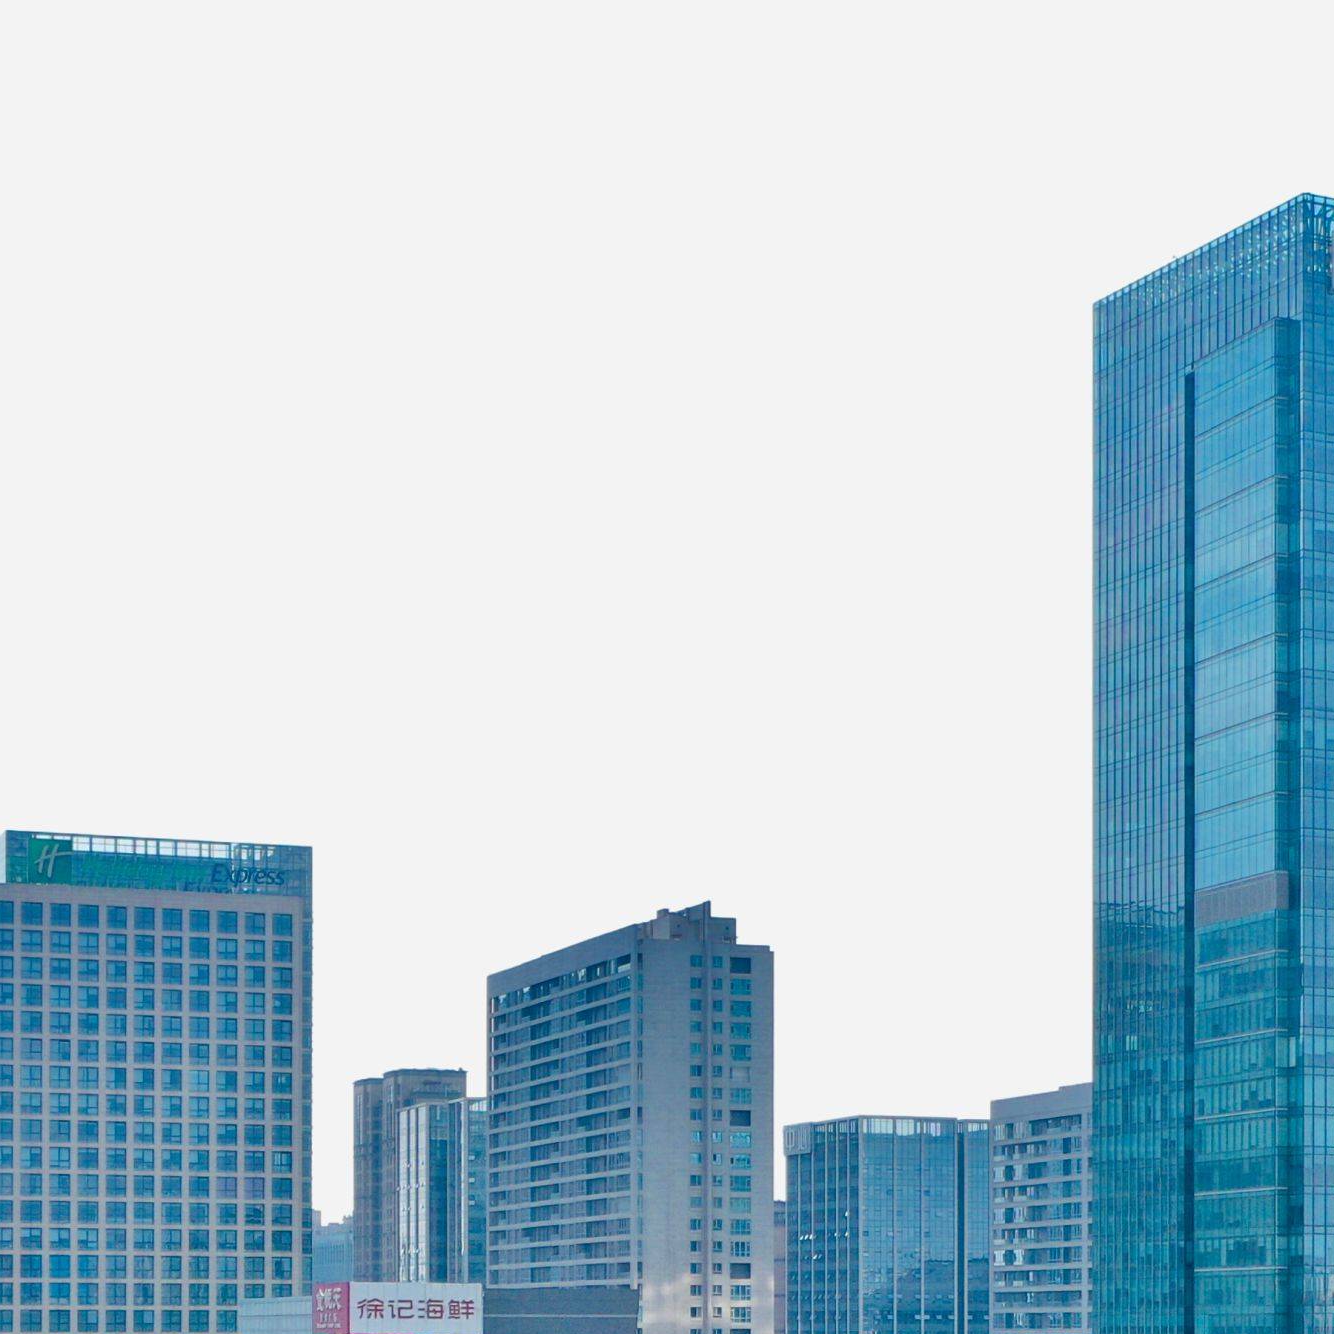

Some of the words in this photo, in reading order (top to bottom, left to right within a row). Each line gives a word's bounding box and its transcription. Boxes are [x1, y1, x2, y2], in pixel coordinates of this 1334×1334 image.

[211, 862, 286, 887] Express
[357, 1298, 474, 1319] 徐记海鲜
